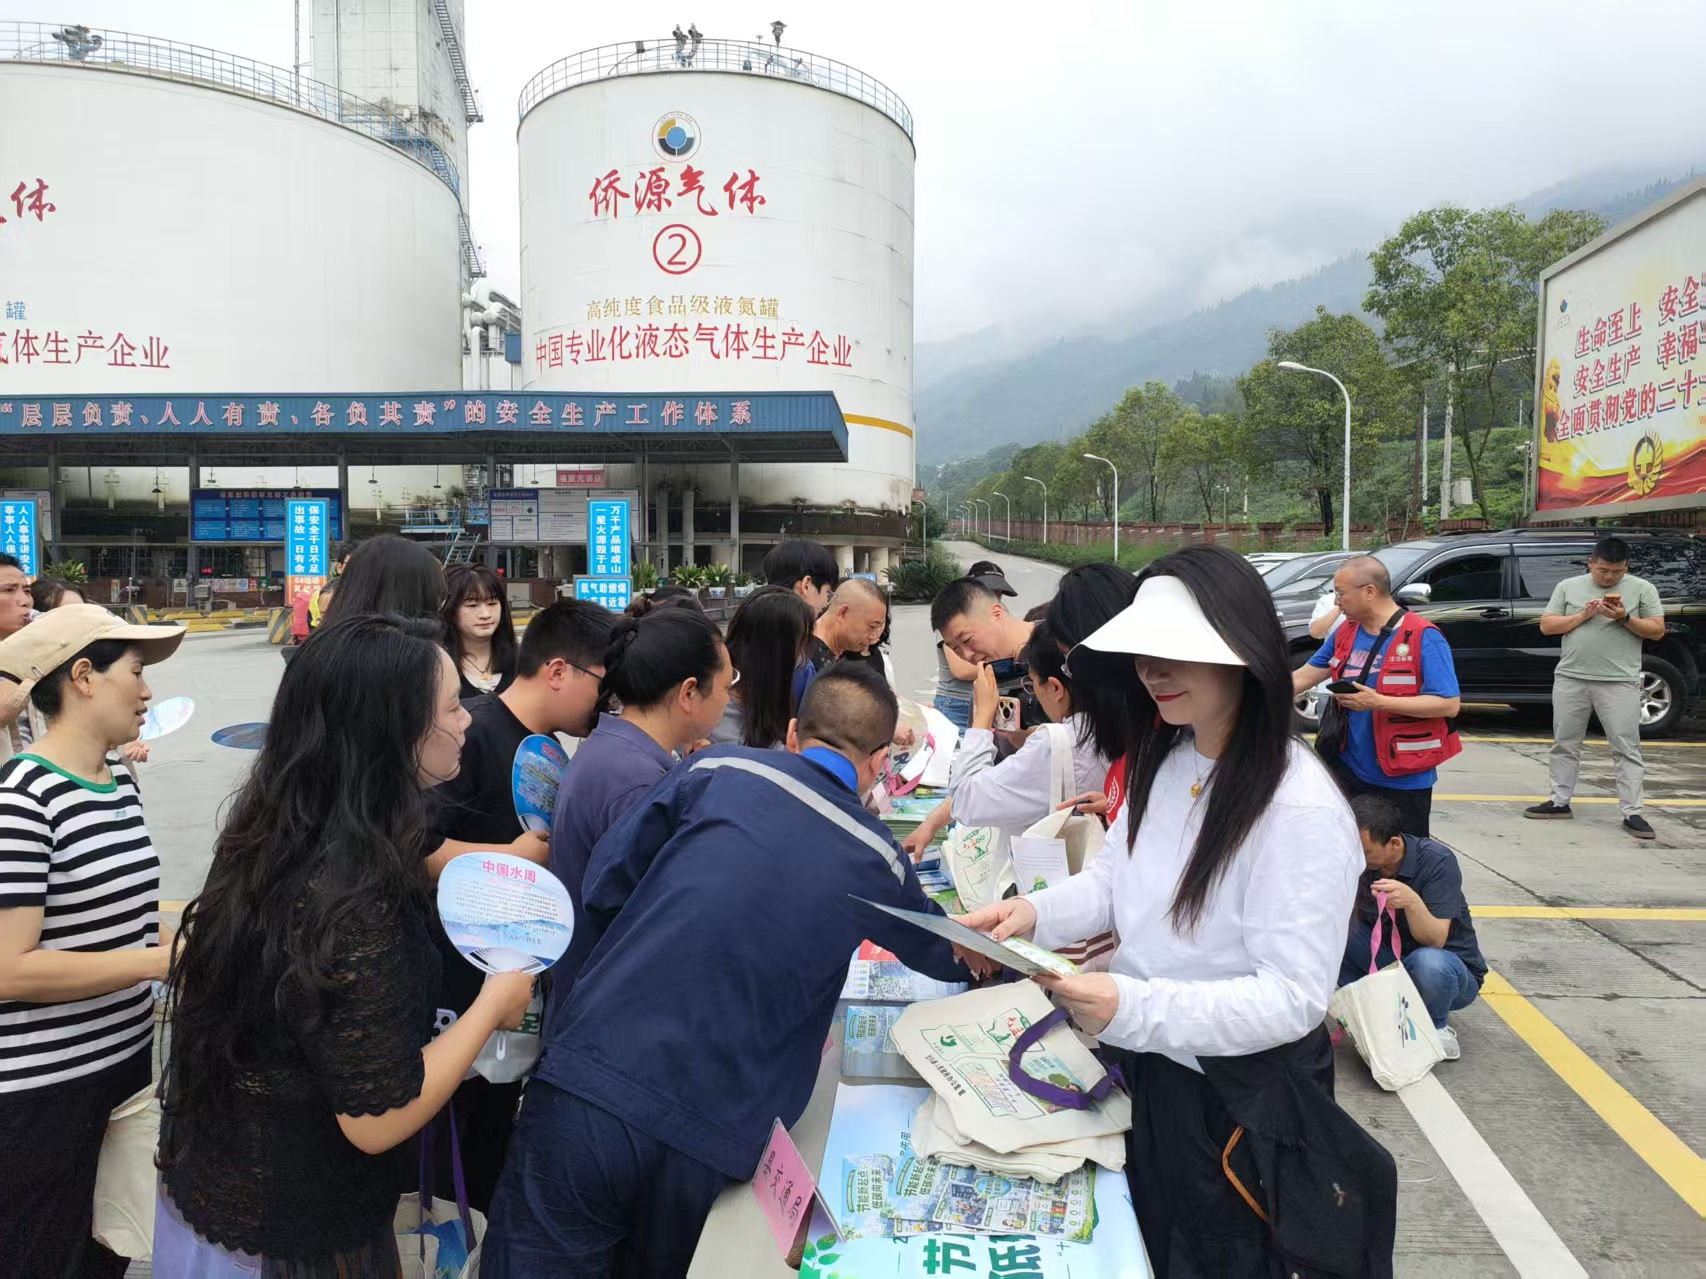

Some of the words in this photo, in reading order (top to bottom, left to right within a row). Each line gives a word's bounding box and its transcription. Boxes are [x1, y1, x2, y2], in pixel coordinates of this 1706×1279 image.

[0, 178, 56, 224] 体
[588, 164, 767, 219] 侨源气体
[5, 300, 27, 321] 罐
[586, 295, 779, 321] 高纯度食品级液氮罐
[1575, 302, 1642, 358] 生命至上
[536, 321, 852, 376] 中国专业化液态气体生产企业
[1658, 320, 1706, 370] 幸福
[1573, 344, 1641, 398] 安全生产
[4, 505, 17, 557] 事事人人保
[294, 505, 306, 574] 出事故一日有余
[308, 505, 320, 574] 保安全千日不足
[610, 505, 621, 574] 万千产品堆成山
[482, 860, 537, 884] 中国水周
[856, 1169, 871, 1213] 节能新起点
[923, 1233, 976, 1275] 节
[988, 1235, 1044, 1279] 低
